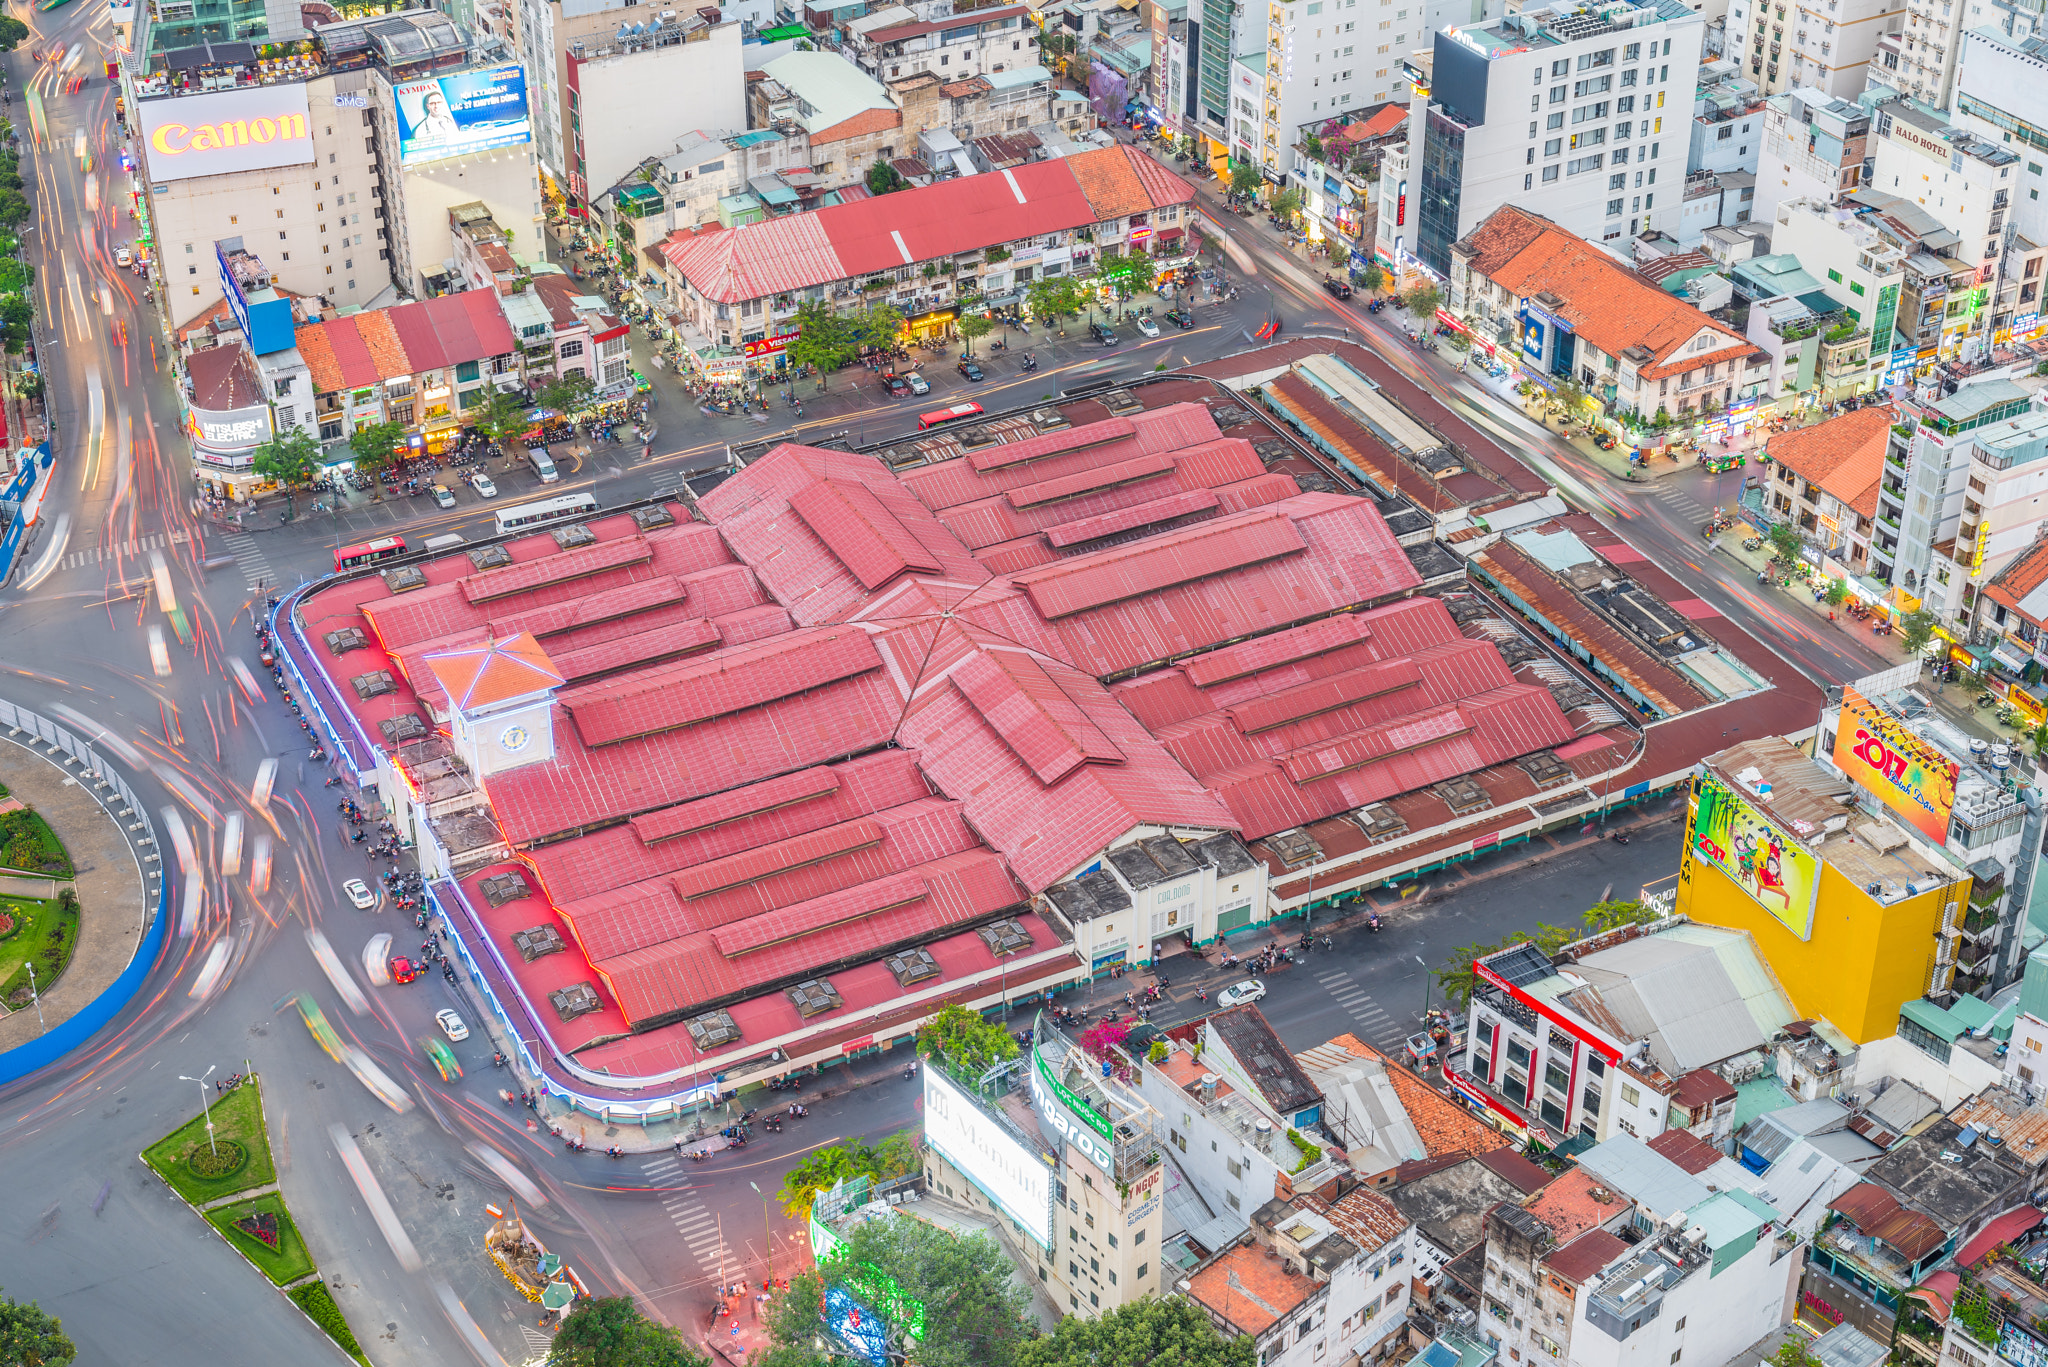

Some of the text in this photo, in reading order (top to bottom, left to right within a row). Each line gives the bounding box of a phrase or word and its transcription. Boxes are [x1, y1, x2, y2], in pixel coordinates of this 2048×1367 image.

[335, 96, 367, 108] OMG!
[399, 83, 437, 96] KYMDAN
[152, 112, 306, 155] Canon
[1895, 126, 1948, 158] HALO HOTEL
[768, 334, 800, 348] VISSAN
[203, 418, 264, 432] MITSUBISHI
[204, 427, 257, 442] ELECTRIC
[1852, 729, 1909, 780] 2017
[1698, 832, 1726, 862] 2017
[1095, 1118, 1109, 1133] RO
[957, 1112, 1048, 1209] Manulife
[1127, 1194, 1160, 1220] COSMETIC
[1127, 1203, 1160, 1228] SURGERY
[1804, 1290, 1832, 1316] SHOP
